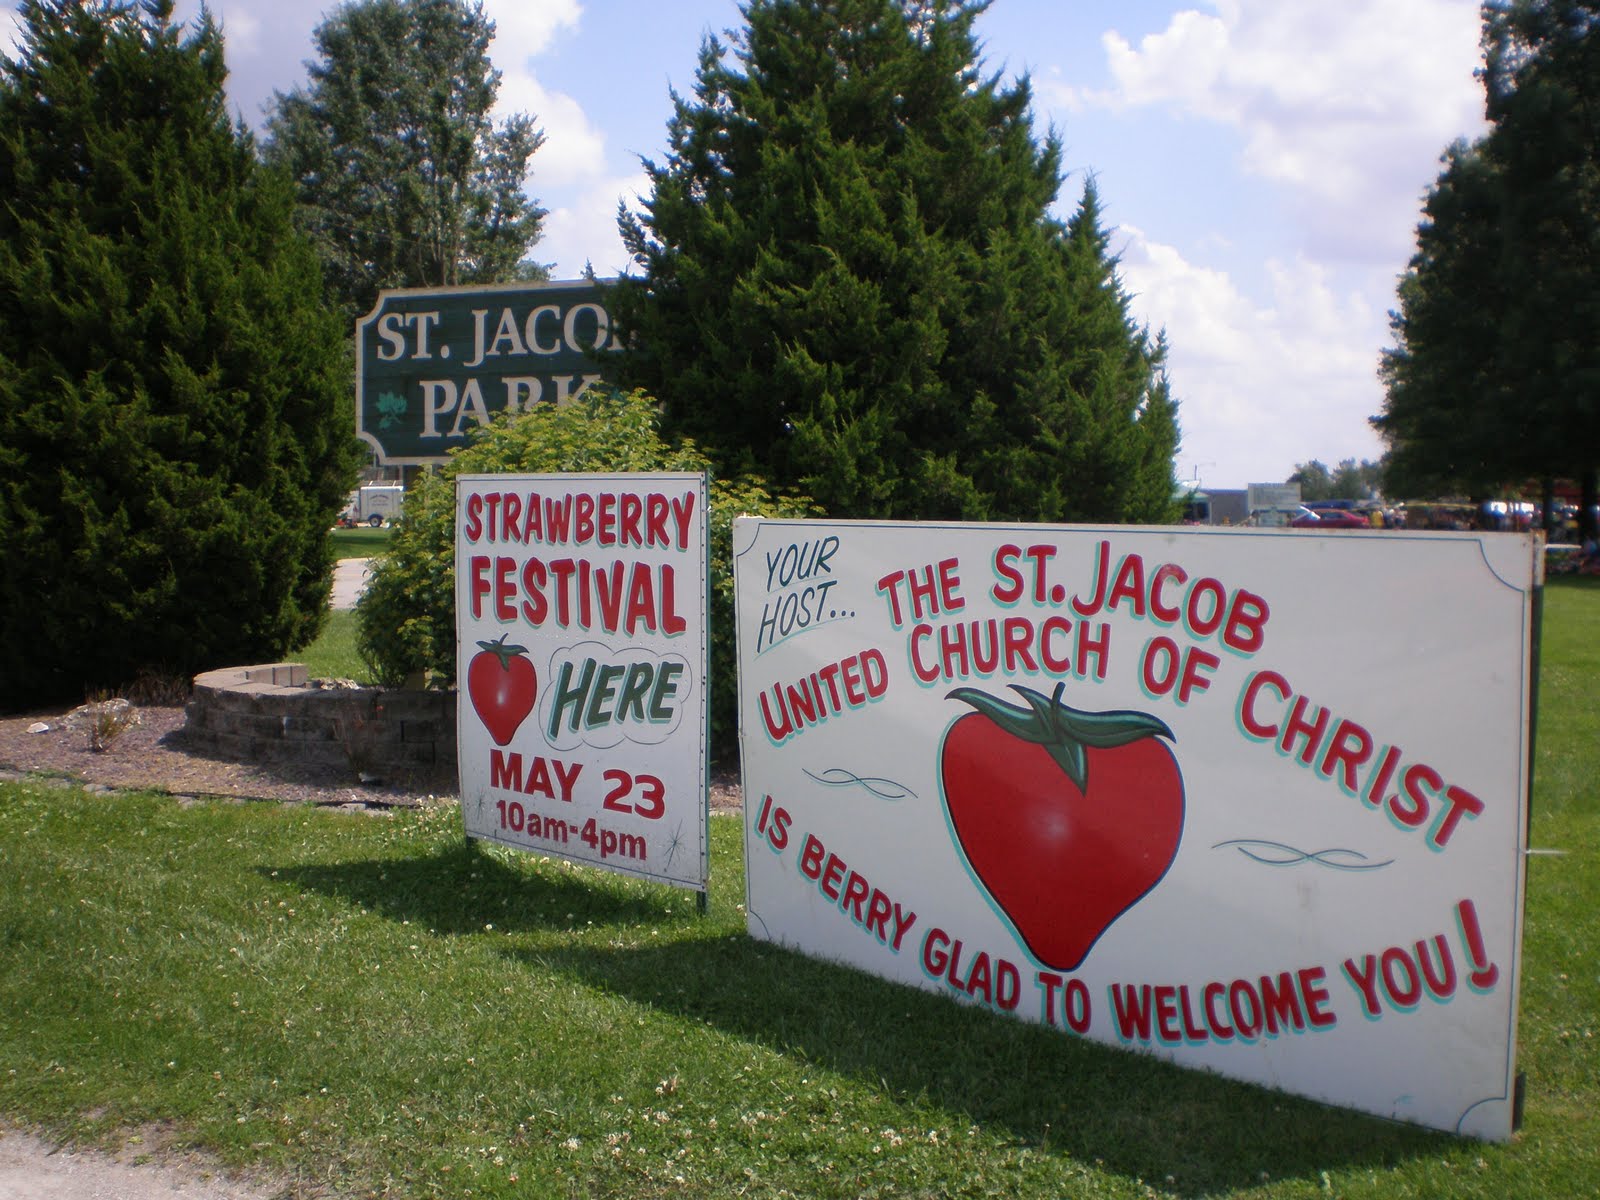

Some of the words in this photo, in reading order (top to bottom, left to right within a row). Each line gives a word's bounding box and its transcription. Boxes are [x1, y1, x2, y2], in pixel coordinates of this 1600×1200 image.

[377, 310, 451, 361] ST.
[463, 302, 633, 368] JACO
[464, 491, 695, 552] STRAWBERRY
[469, 555, 687, 639] FESTIVAL
[766, 535, 840, 593] YOUR
[876, 557, 966, 631] THE
[989, 544, 1066, 607] ST.
[1070, 540, 1271, 657] JACOB
[757, 580, 856, 654] HOST...
[546, 657, 684, 742] HERE
[758, 648, 890, 747] UNITED
[908, 615, 1112, 688] CHURCH
[1138, 635, 1222, 707] OF
[1235, 670, 1486, 853] CHRIST
[490, 748, 584, 803] MAY
[602, 768, 666, 820] 23
[496, 799, 647, 861] 10am-4pm
[754, 794, 793, 855] IS
[797, 832, 917, 954] BERRY
[919, 927, 1021, 1012] GLAD
[1034, 971, 1091, 1035] TO
[1111, 966, 1338, 1047] WELCOME
[1340, 898, 1500, 1022] YOU!
